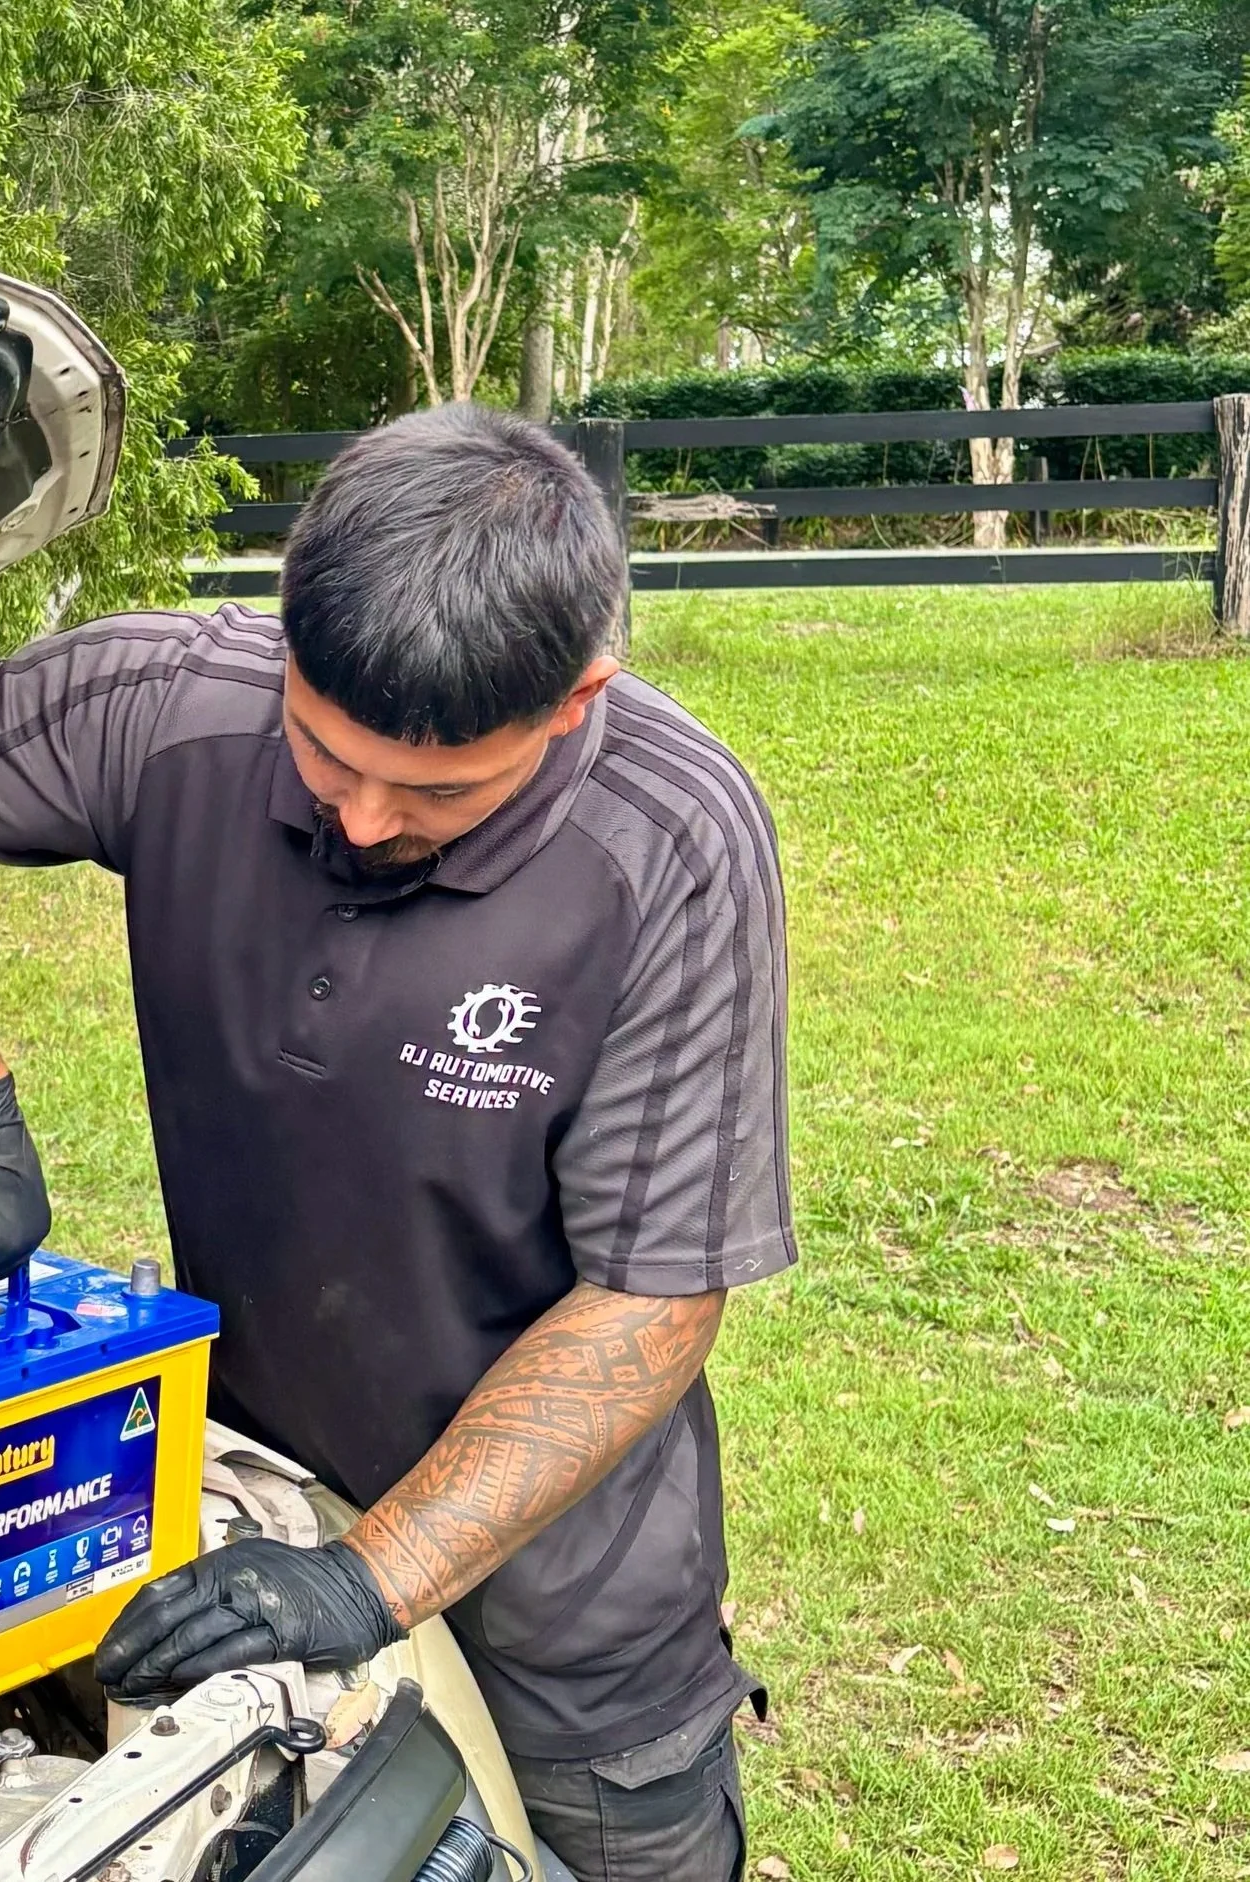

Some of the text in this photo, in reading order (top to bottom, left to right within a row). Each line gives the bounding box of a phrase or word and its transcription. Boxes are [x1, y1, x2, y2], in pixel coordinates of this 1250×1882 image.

[400, 1043, 555, 1095] AJ AUTOMOTIVE
[424, 1078, 520, 1109] SERVICES
